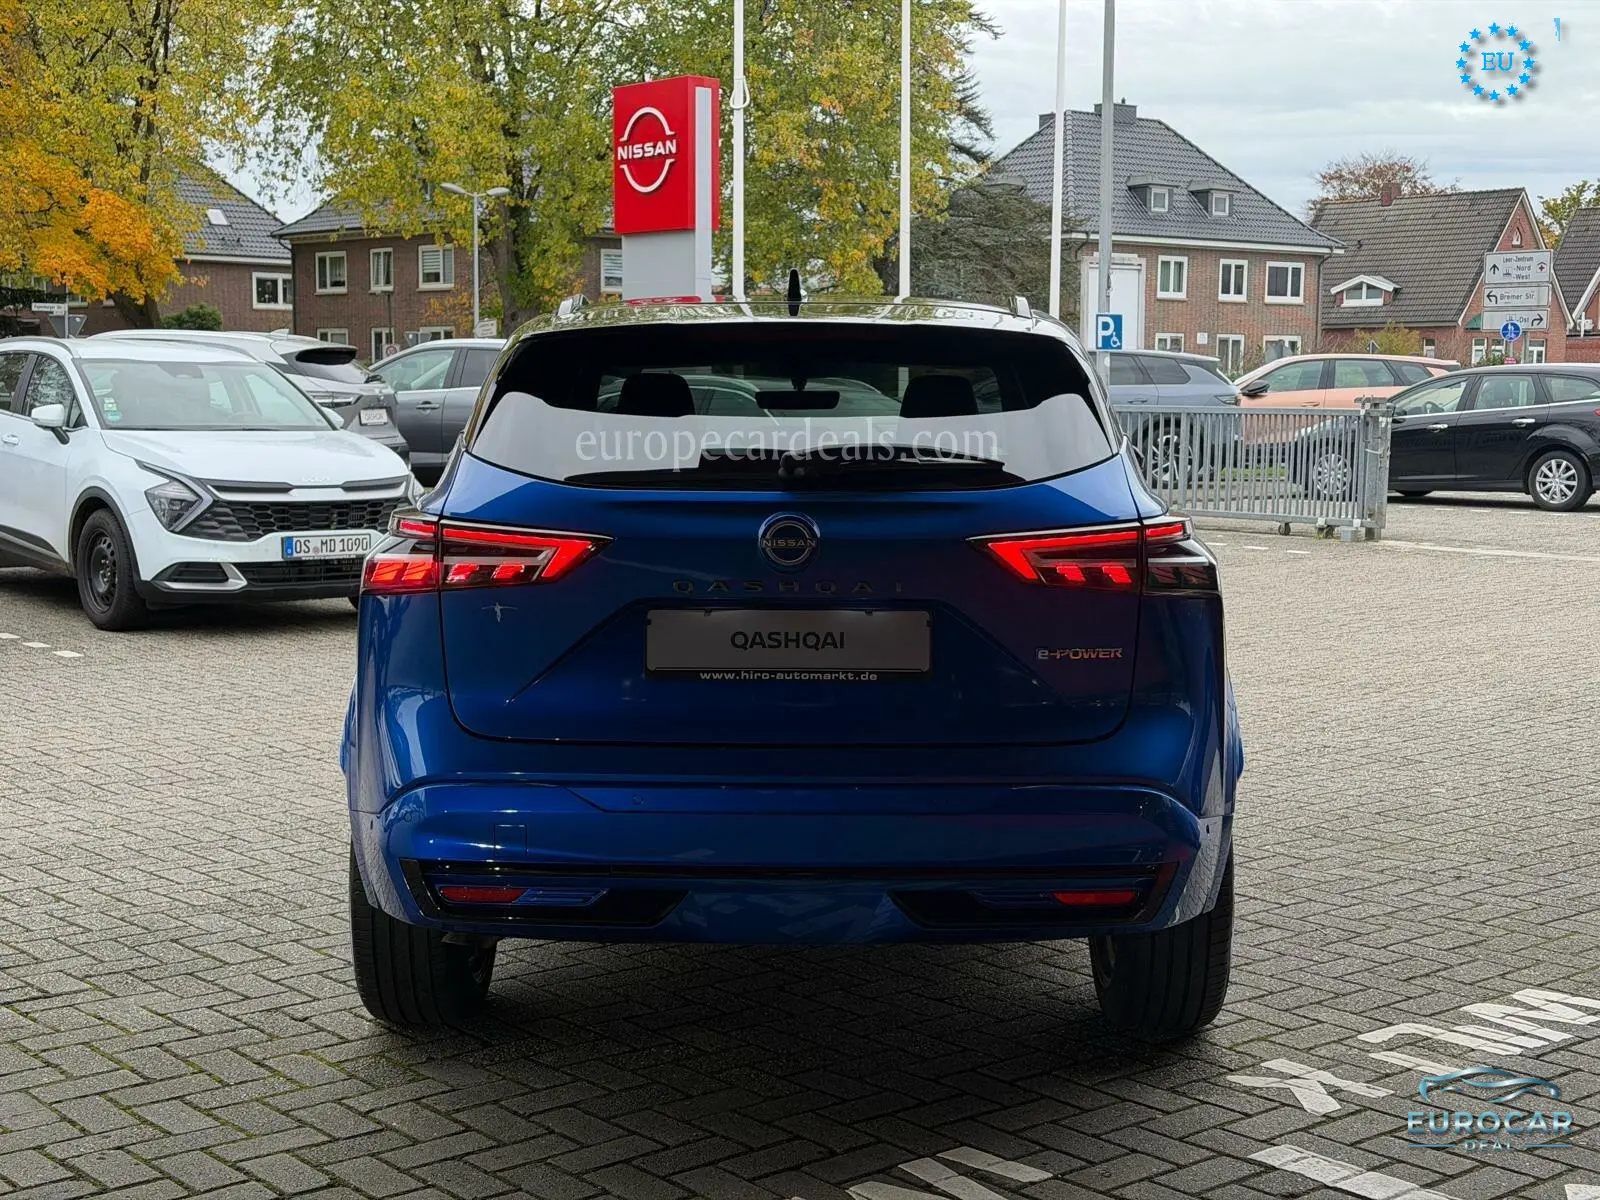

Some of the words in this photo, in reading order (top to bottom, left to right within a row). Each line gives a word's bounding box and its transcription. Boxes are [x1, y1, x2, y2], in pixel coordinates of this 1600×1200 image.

[617, 140, 676, 160] NISSAN
[1500, 293, 1523, 301] Bremer
[1097, 316, 1115, 348] P
[294, 539, 311, 554] OS
[320, 539, 336, 553] MD
[339, 537, 368, 552] 1090
[761, 538, 817, 548] NISSAN
[672, 580, 902, 594] QASHQAI
[730, 631, 845, 650] QASHQAI
[1036, 647, 1123, 659] e-POWER
[699, 670, 878, 682] www.hiro-automarkt.de
